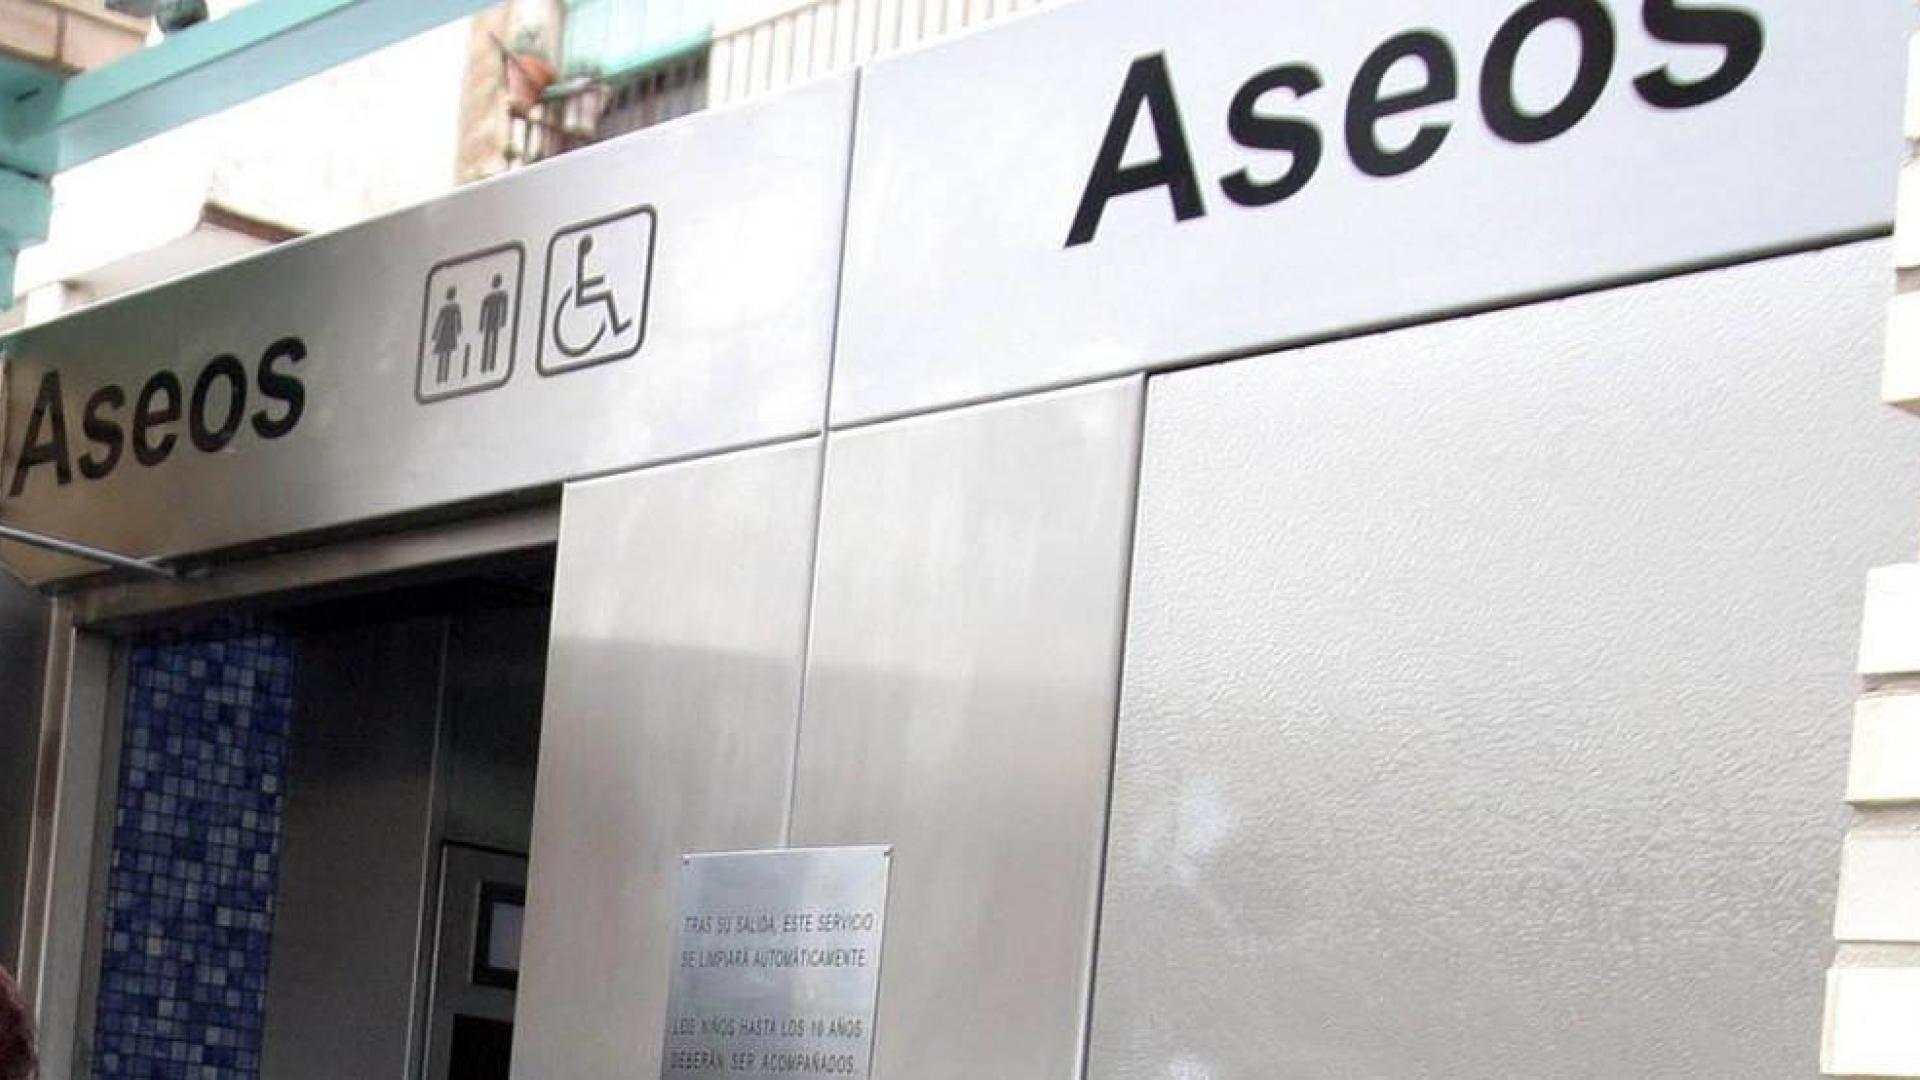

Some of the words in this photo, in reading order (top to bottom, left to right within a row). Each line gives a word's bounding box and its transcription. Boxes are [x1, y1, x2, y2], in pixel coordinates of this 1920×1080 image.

[1064, 0, 1764, 248] Aseos
[9, 336, 307, 497] Aseos
[684, 915, 712, 933] TRAS
[717, 915, 731, 933] SU
[783, 913, 814, 932] ESTE
[818, 912, 874, 932] SERVICIO
[680, 950, 696, 968] SE
[672, 1016, 696, 1036] LOS
[700, 1015, 736, 1037] NIÑOS
[740, 1016, 777, 1036] HASTA
[780, 1018, 806, 1038] LOS
[826, 1015, 864, 1039] AÑOS
[670, 1048, 725, 1070] DEBERÁN
[730, 1051, 756, 1072] SER
